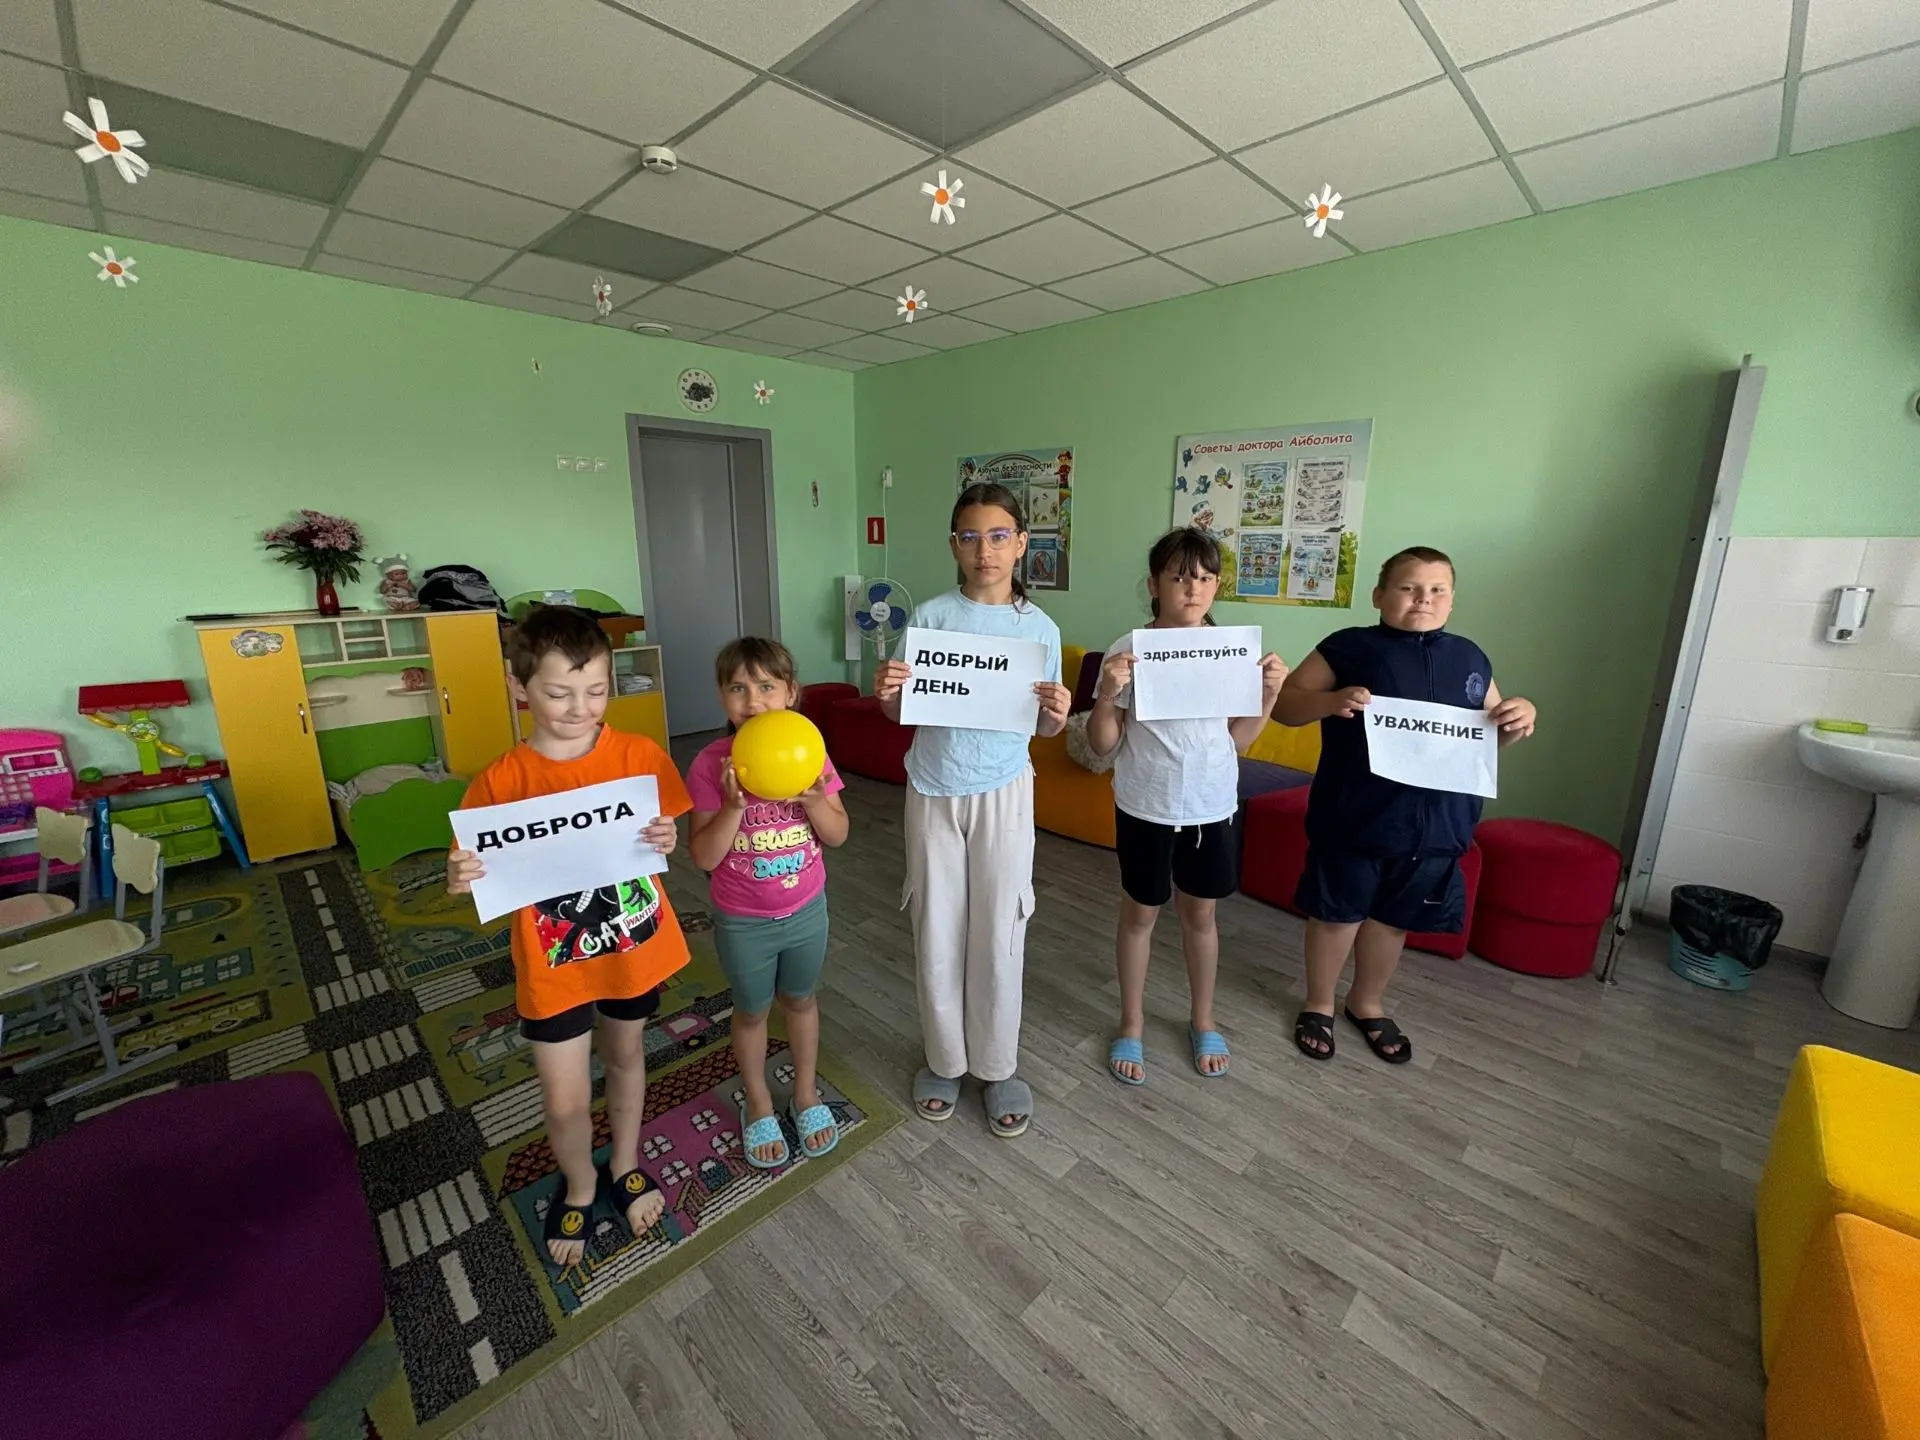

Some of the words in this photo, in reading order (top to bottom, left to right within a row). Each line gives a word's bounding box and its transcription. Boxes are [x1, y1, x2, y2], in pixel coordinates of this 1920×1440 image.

[1194, 444, 1233, 455] Советы
[1237, 440, 1284, 452] доктора
[1289, 434, 1353, 448] Айболита
[1001, 462, 1053, 473] безопасности
[914, 649, 1009, 672] ДОБРЫЙ
[1143, 645, 1248, 662] здравствуйте
[912, 678, 971, 696] ДЕНЬ
[1373, 714, 1484, 741] УВАЖЕНИЕ
[744, 801, 805, 827] HAVE
[476, 801, 635, 852] ДОБРОТА
[733, 832, 750, 853] A
[751, 824, 812, 852] SWEE
[624, 902, 658, 930] WANTED
